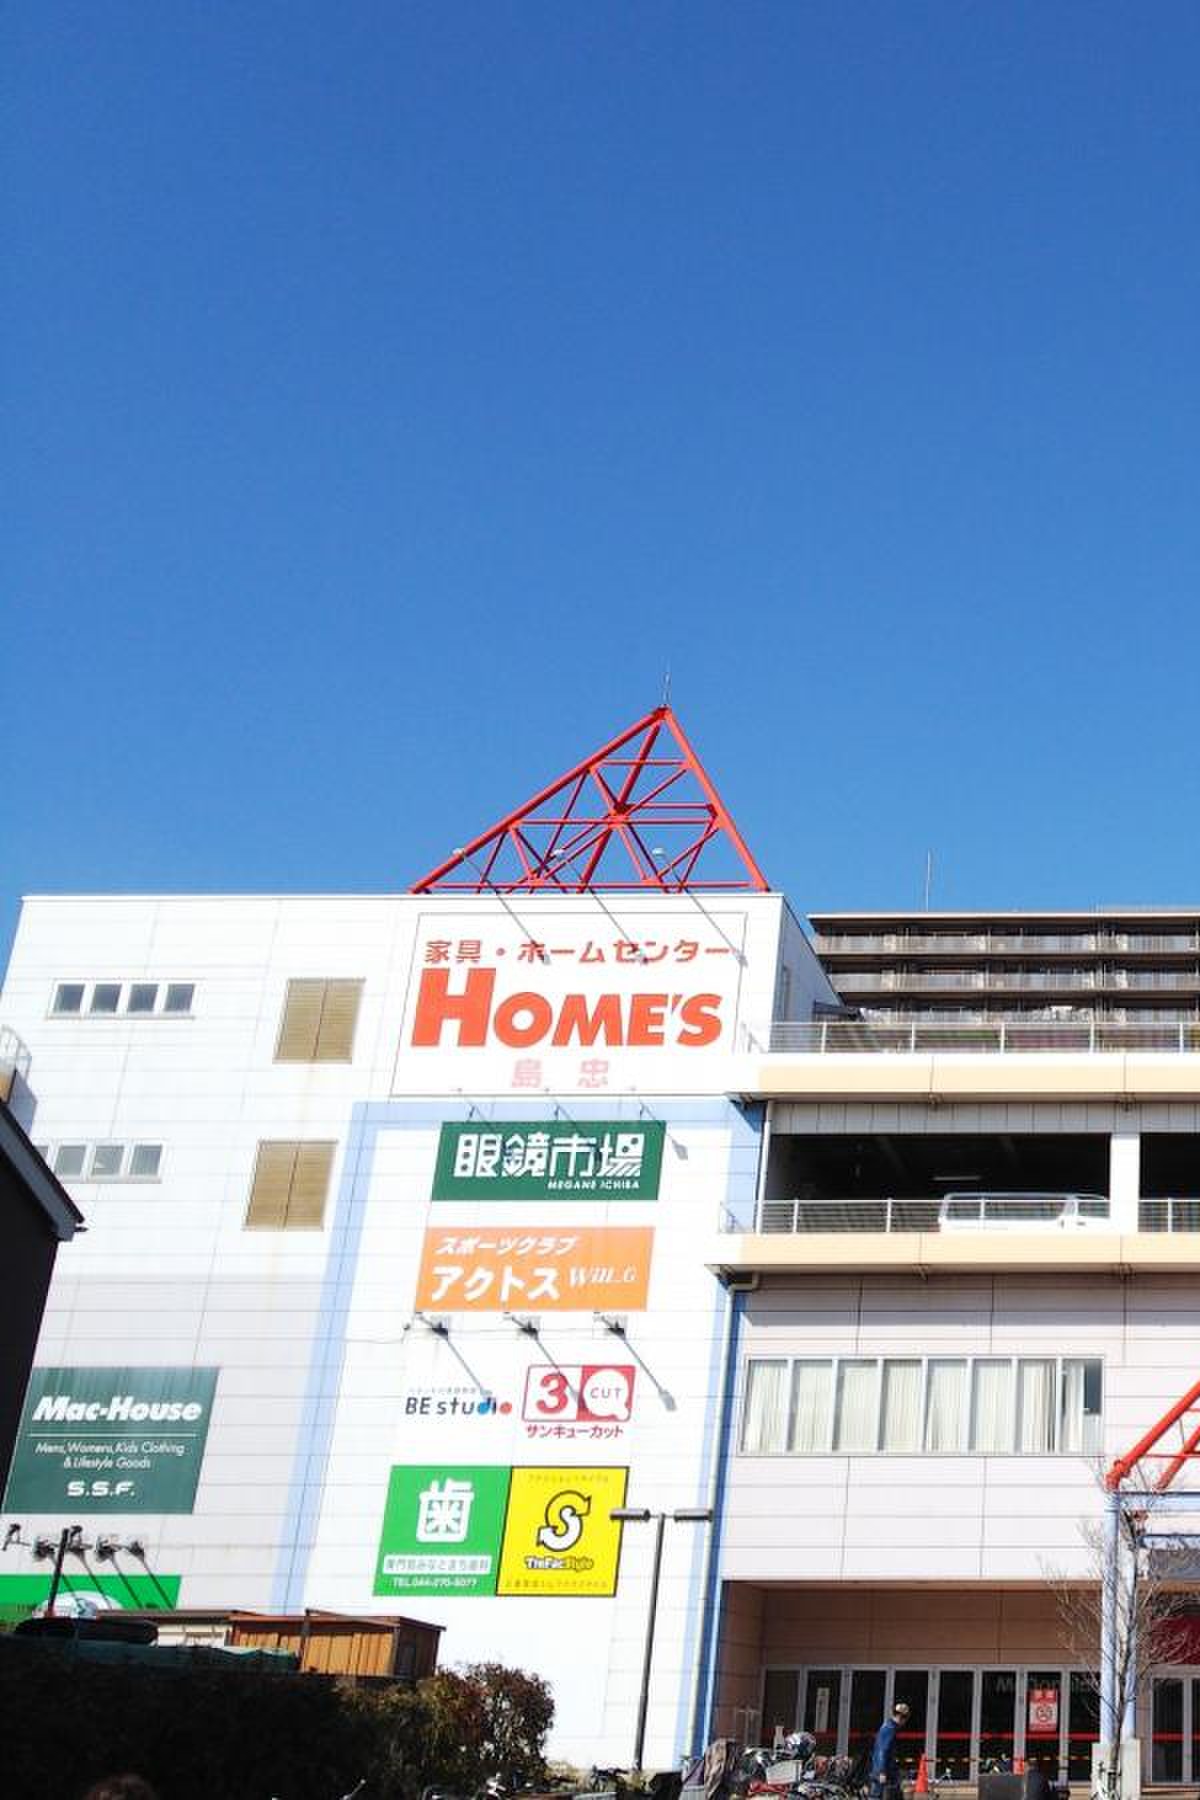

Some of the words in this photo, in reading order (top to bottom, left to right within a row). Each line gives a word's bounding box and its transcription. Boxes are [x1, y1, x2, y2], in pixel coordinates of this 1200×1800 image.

[423, 939, 731, 963] 家具・ホームセンター
[410, 967, 723, 1048] HOME'S
[453, 1132, 645, 1177] 眼鏡市場
[548, 1180, 596, 1190] MEGANE
[599, 1180, 640, 1190] ICHIBA
[435, 1236, 580, 1256] スポーツクラブ
[431, 1265, 560, 1302] アクトス
[590, 1388, 621, 1399] CUT
[31, 1396, 202, 1421] Mac-House
[405, 1397, 431, 1415] BE
[526, 1425, 624, 1438] サンキューカット
[141, 1441, 185, 1456] Clothing
[73, 1456, 114, 1470] Lifestyle
[116, 1456, 151, 1469] Goods
[67, 1481, 135, 1496] S.S.F.
